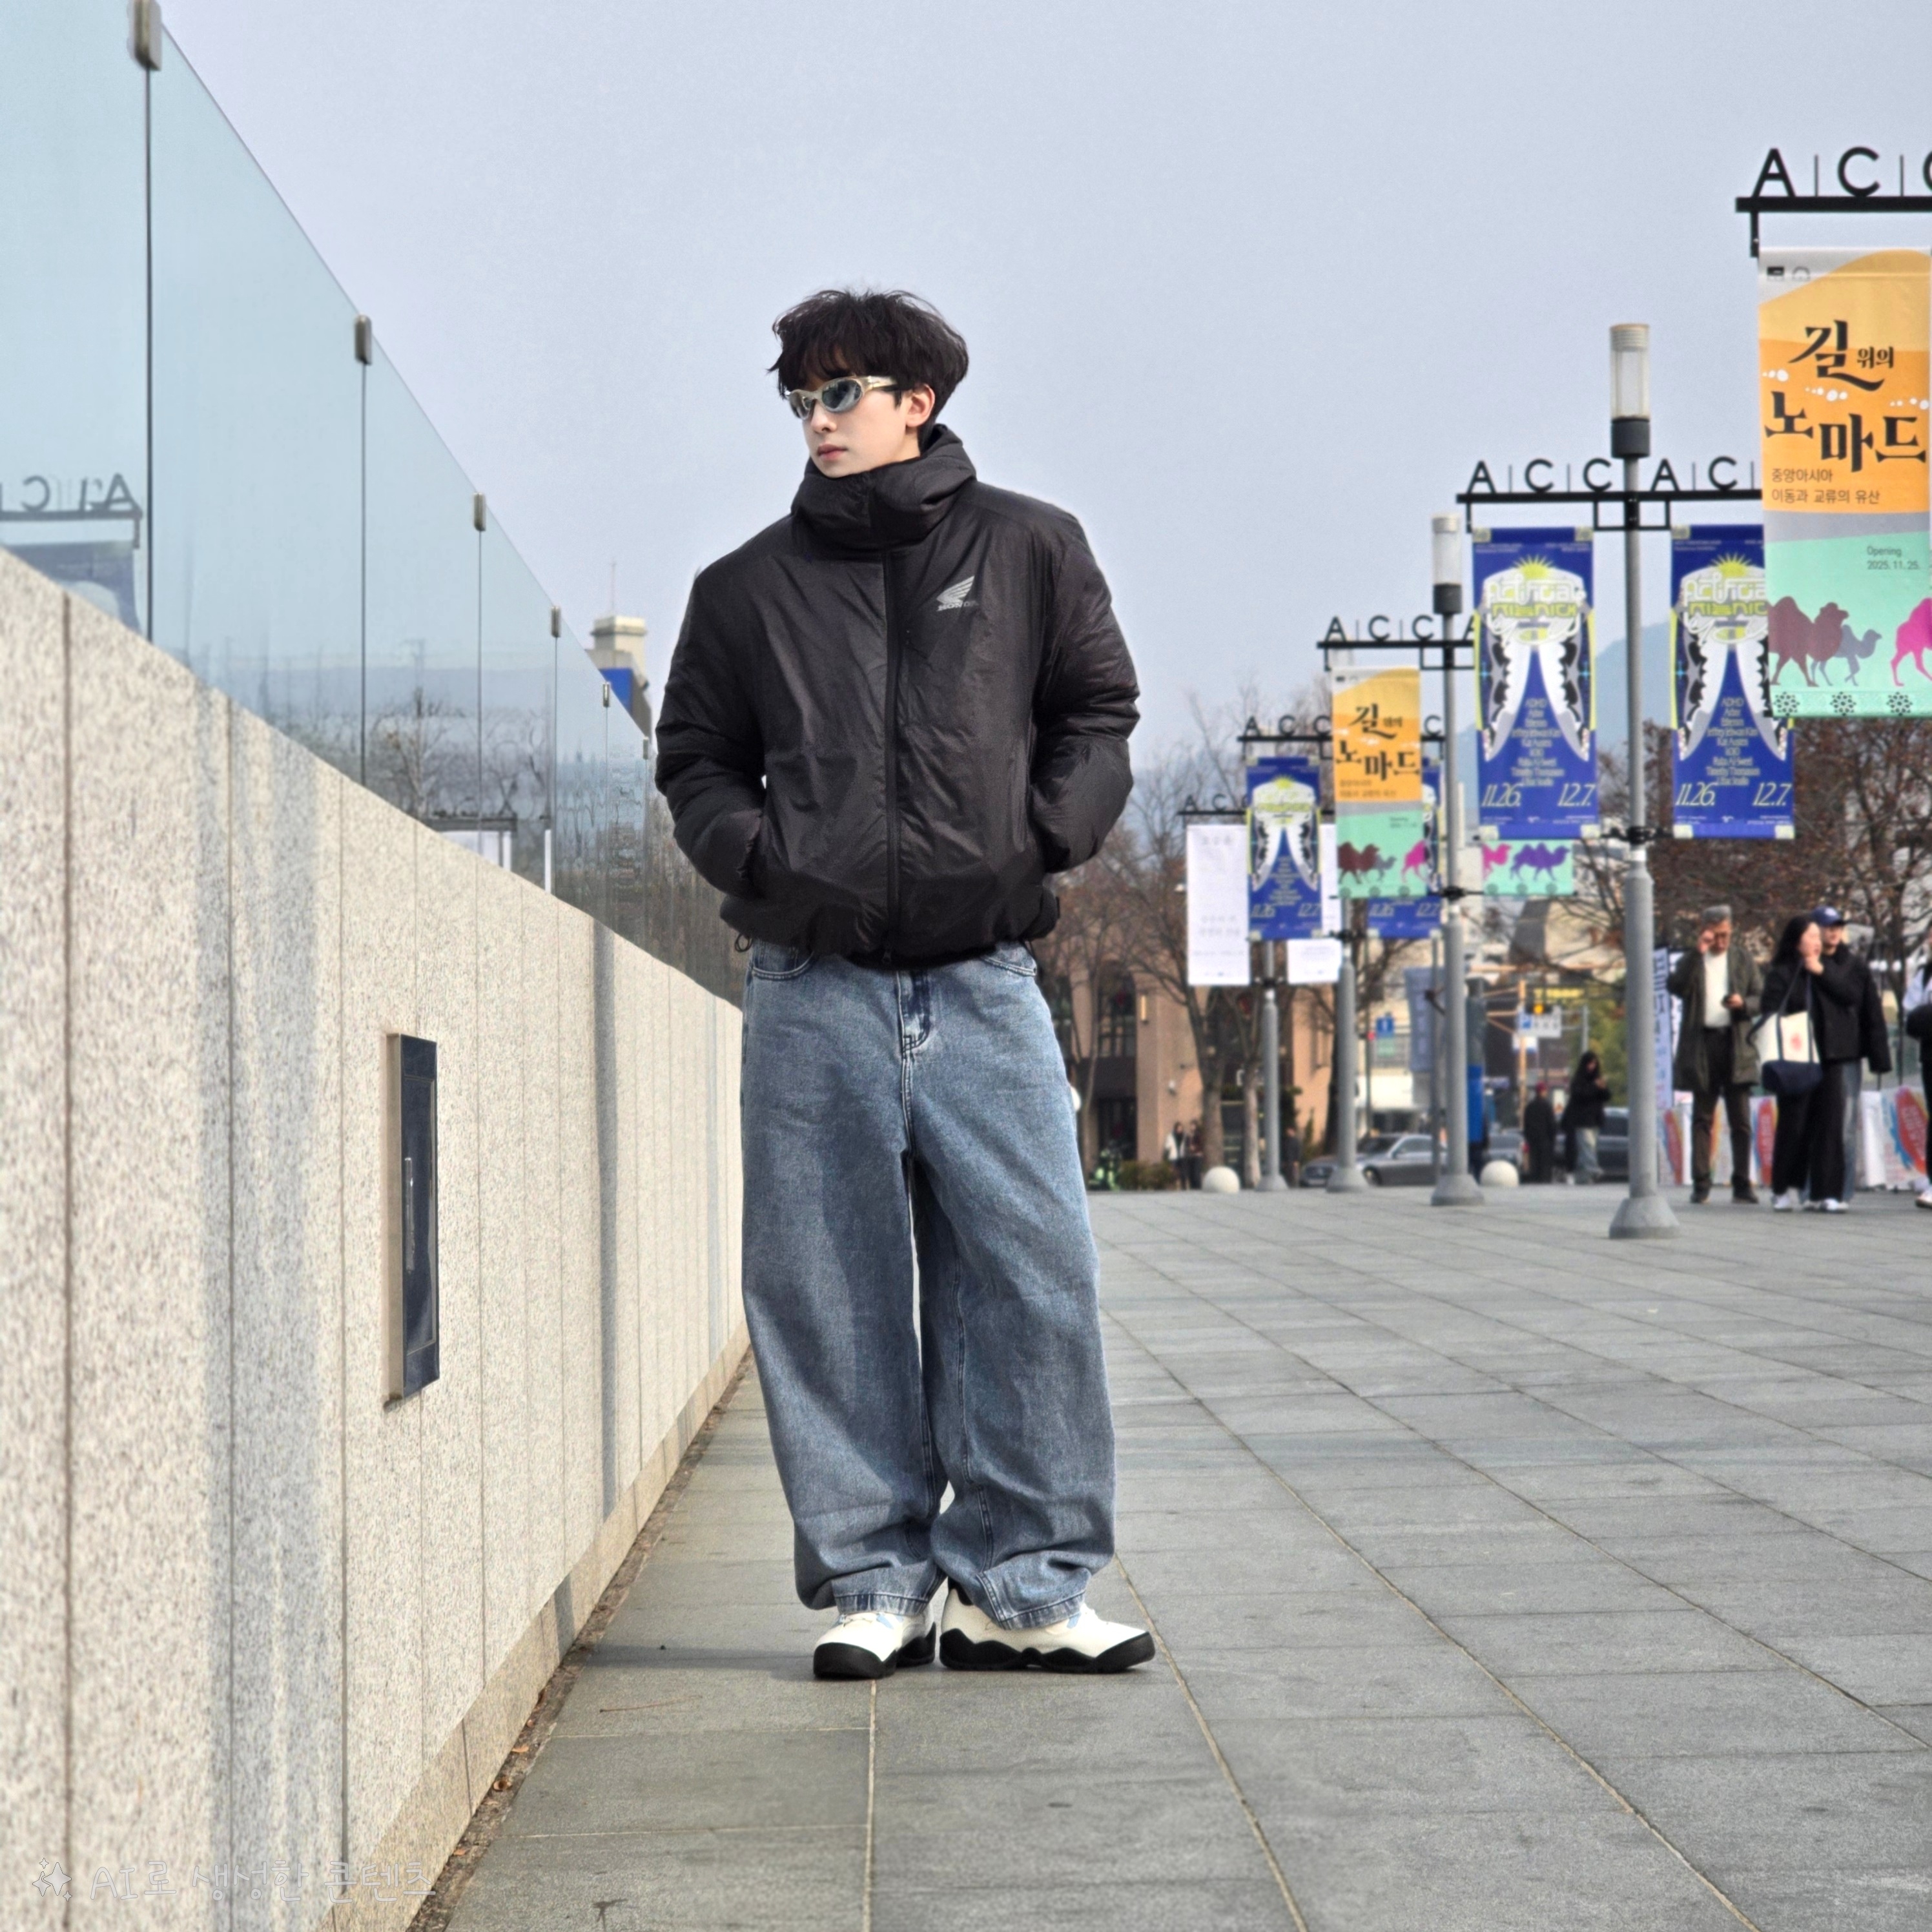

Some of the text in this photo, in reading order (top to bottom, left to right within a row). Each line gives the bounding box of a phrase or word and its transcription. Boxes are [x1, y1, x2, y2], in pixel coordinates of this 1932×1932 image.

[1788, 320, 1894, 392] 길 위의
[1764, 391, 1926, 473] 노마드
[1772, 468, 1833, 483] 중앙아시아
[1772, 489, 1880, 504] 이동과 교류의 유산
[1867, 546, 1902, 558] Opening
[1349, 703, 1397, 740] 길
[1336, 740, 1419, 781] 노마드
